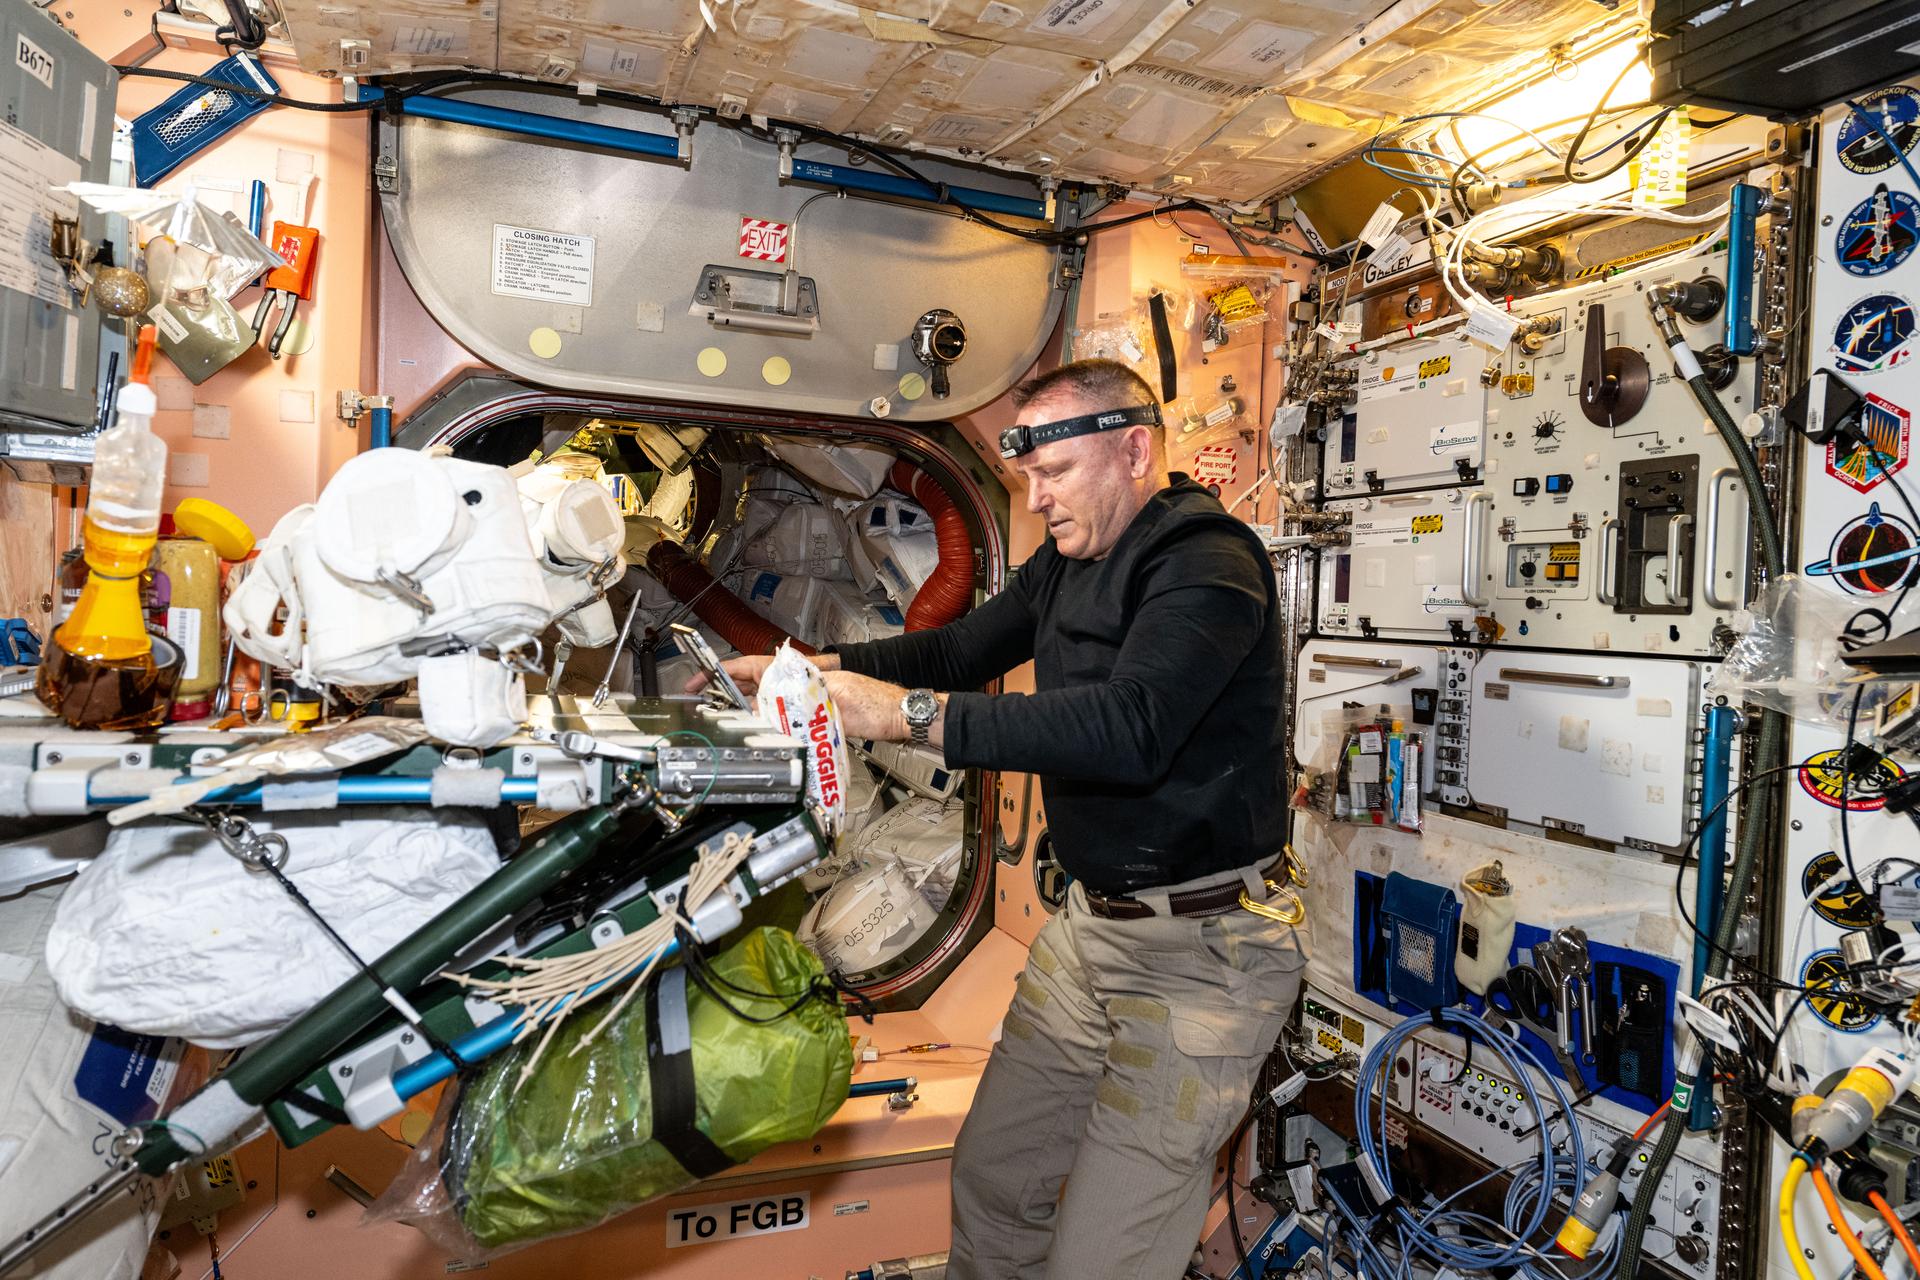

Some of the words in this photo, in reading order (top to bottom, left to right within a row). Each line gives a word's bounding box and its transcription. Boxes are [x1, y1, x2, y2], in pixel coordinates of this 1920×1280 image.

[20, 41, 53, 81] B677
[1840, 152, 1853, 168] ROSS
[1854, 162, 1888, 173] NEWMAN
[514, 231, 550, 242] CLOSING
[552, 236, 581, 247] HATCH
[748, 229, 781, 252] EXIT
[1644, 246, 1667, 258] Obstruct
[1667, 239, 1692, 251] Opening
[1362, 375, 1380, 385] FRIDGE
[1877, 399, 1900, 415] FRICK
[1097, 414, 1127, 429] PETZL
[1034, 426, 1070, 439] TIKKA
[1834, 471, 1856, 486] OCHOA
[808, 703, 841, 808] HUGGIES
[843, 899, 895, 948] 05-5325
[120, 1059, 133, 1088] SHELF
[1428, 1084, 1444, 1096] GALLEY
[673, 1211, 717, 1241] To
[730, 1196, 804, 1235] FGB
